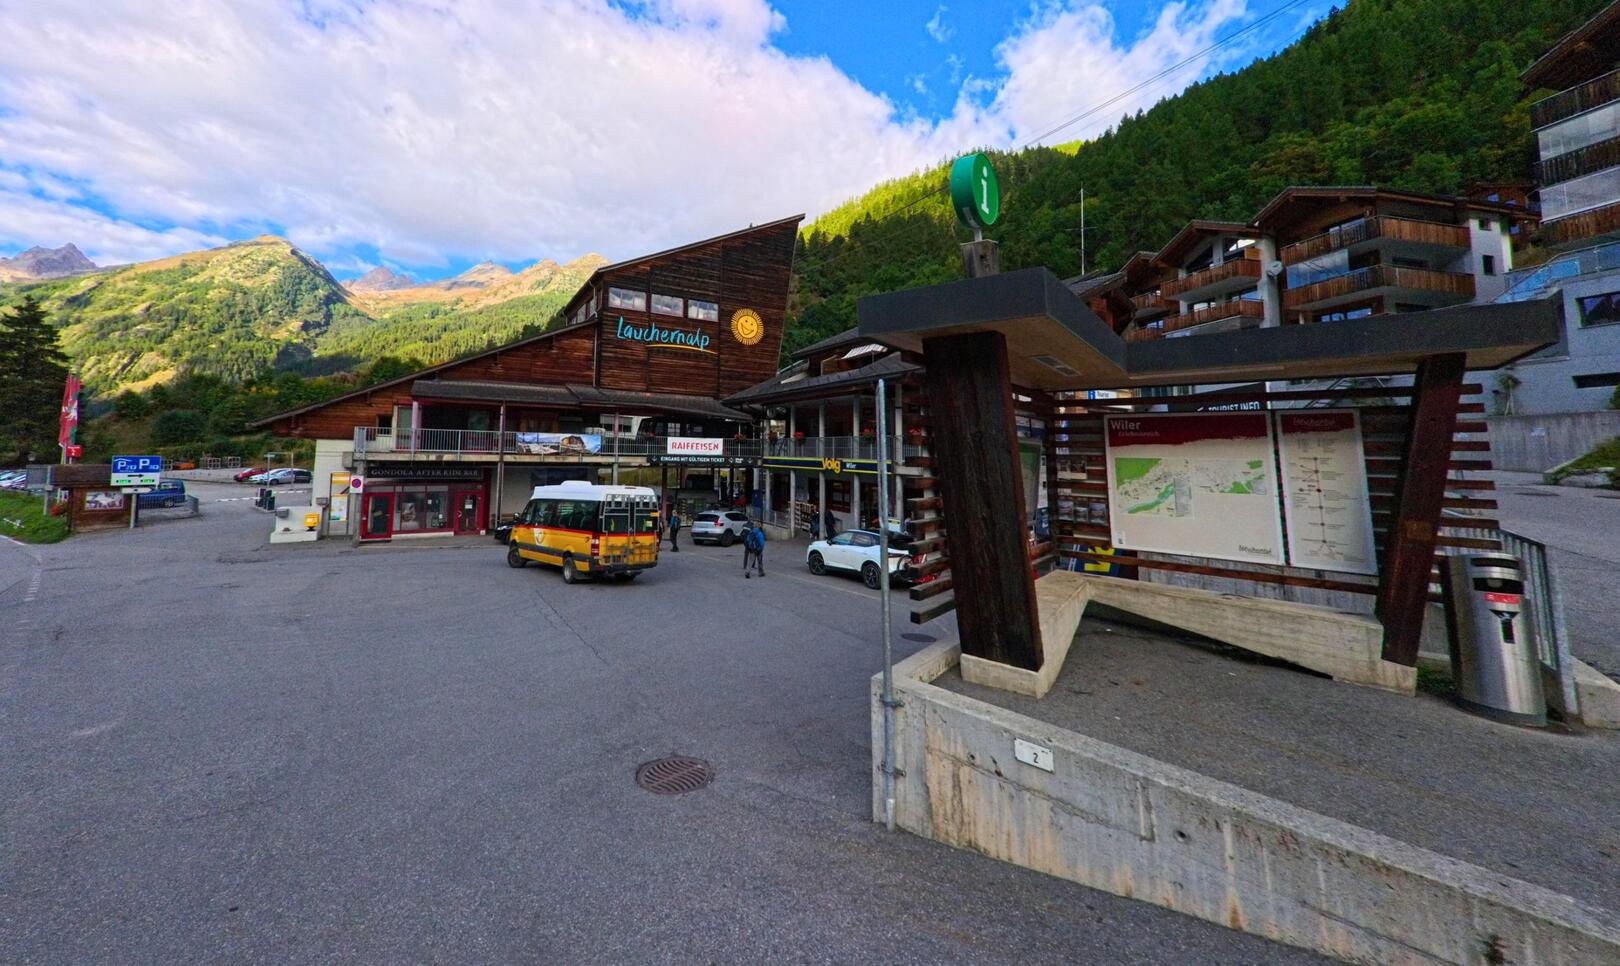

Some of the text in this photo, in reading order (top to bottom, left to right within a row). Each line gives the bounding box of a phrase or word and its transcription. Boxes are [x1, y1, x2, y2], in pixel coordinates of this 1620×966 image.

[981, 166, 989, 214] i
[616, 316, 709, 352] Lauchernalp
[1110, 419, 1141, 431] Wiler
[671, 442, 719, 451] RAIFFEISEN
[822, 457, 841, 474] Volg
[371, 469, 413, 477] GONDOLA
[1033, 752, 1040, 764] 2
